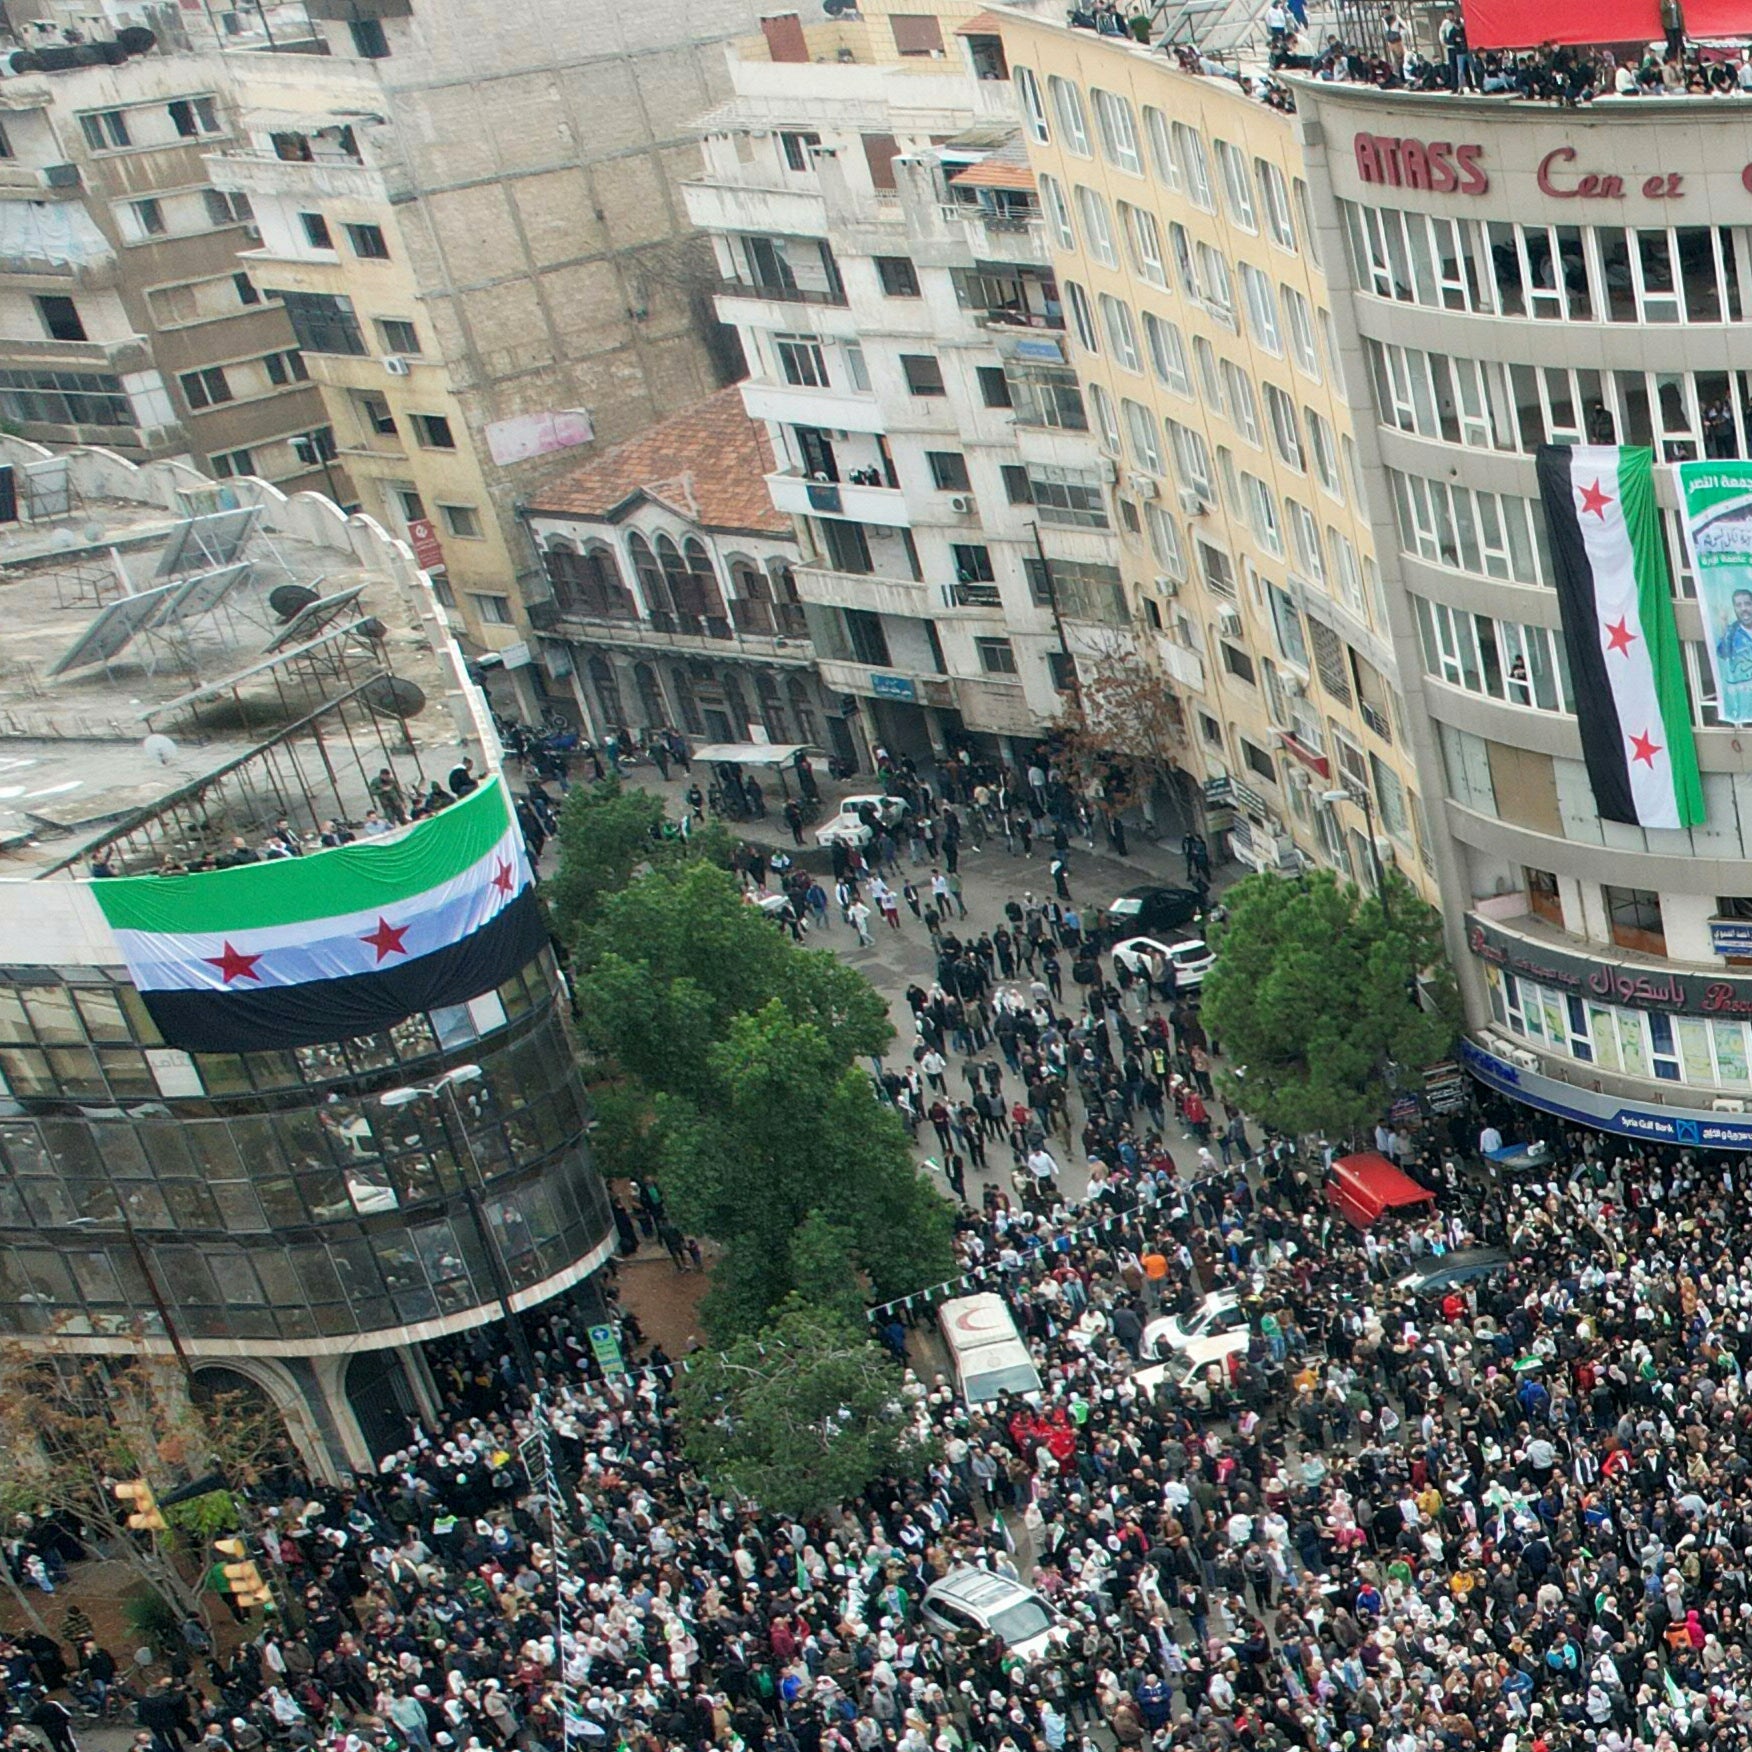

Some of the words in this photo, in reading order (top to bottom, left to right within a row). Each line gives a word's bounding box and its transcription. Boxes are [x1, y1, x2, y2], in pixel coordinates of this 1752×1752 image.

[1354, 131, 1489, 196] ATASS
[1589, 966, 1684, 1007] باسكوال
[1621, 1116, 1639, 1129] Syria
[1638, 1119, 1655, 1131] Gulf
[1654, 1122, 1674, 1134] Bank
